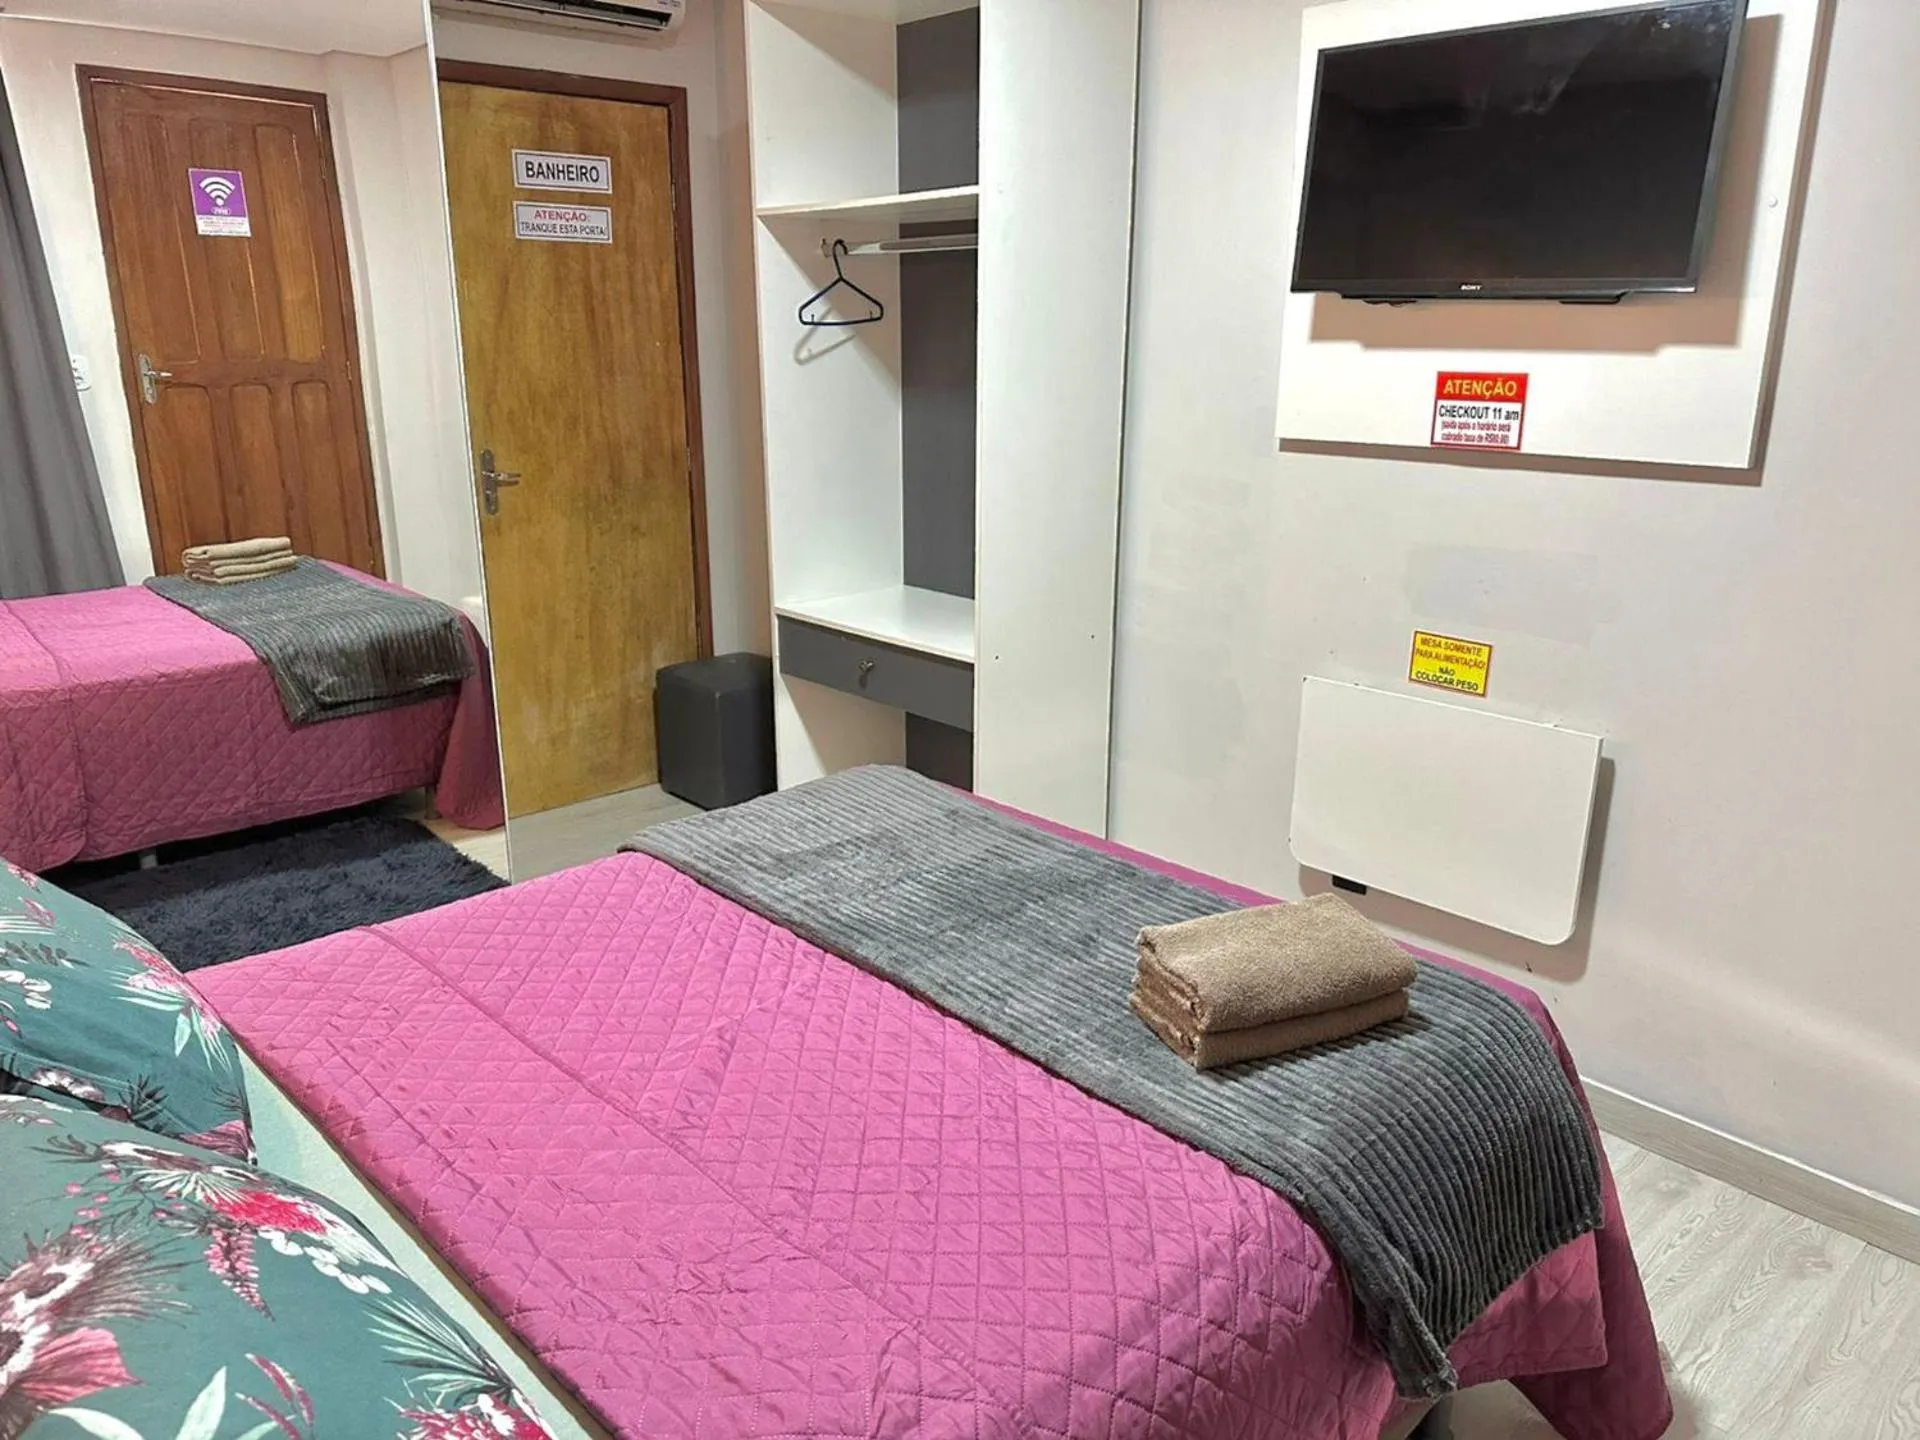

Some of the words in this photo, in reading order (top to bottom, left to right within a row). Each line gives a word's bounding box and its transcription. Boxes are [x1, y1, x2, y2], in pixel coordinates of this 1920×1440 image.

[525, 161, 600, 182] BANHEIRO
[521, 222, 558, 233] TRANQUE
[560, 224, 578, 234] ESTA
[1443, 378, 1517, 400] ATENÇÃO
[1439, 405, 1490, 419] CHECKOUT
[1492, 407, 1502, 419] 11
[1505, 410, 1519, 420] am
[1420, 638, 1442, 647] MESA
[1443, 641, 1483, 657] SOMENTE
[1415, 670, 1454, 685] COLOCAR
[1455, 679, 1479, 691] PESO
[1438, 666, 1456, 676] NÃO
